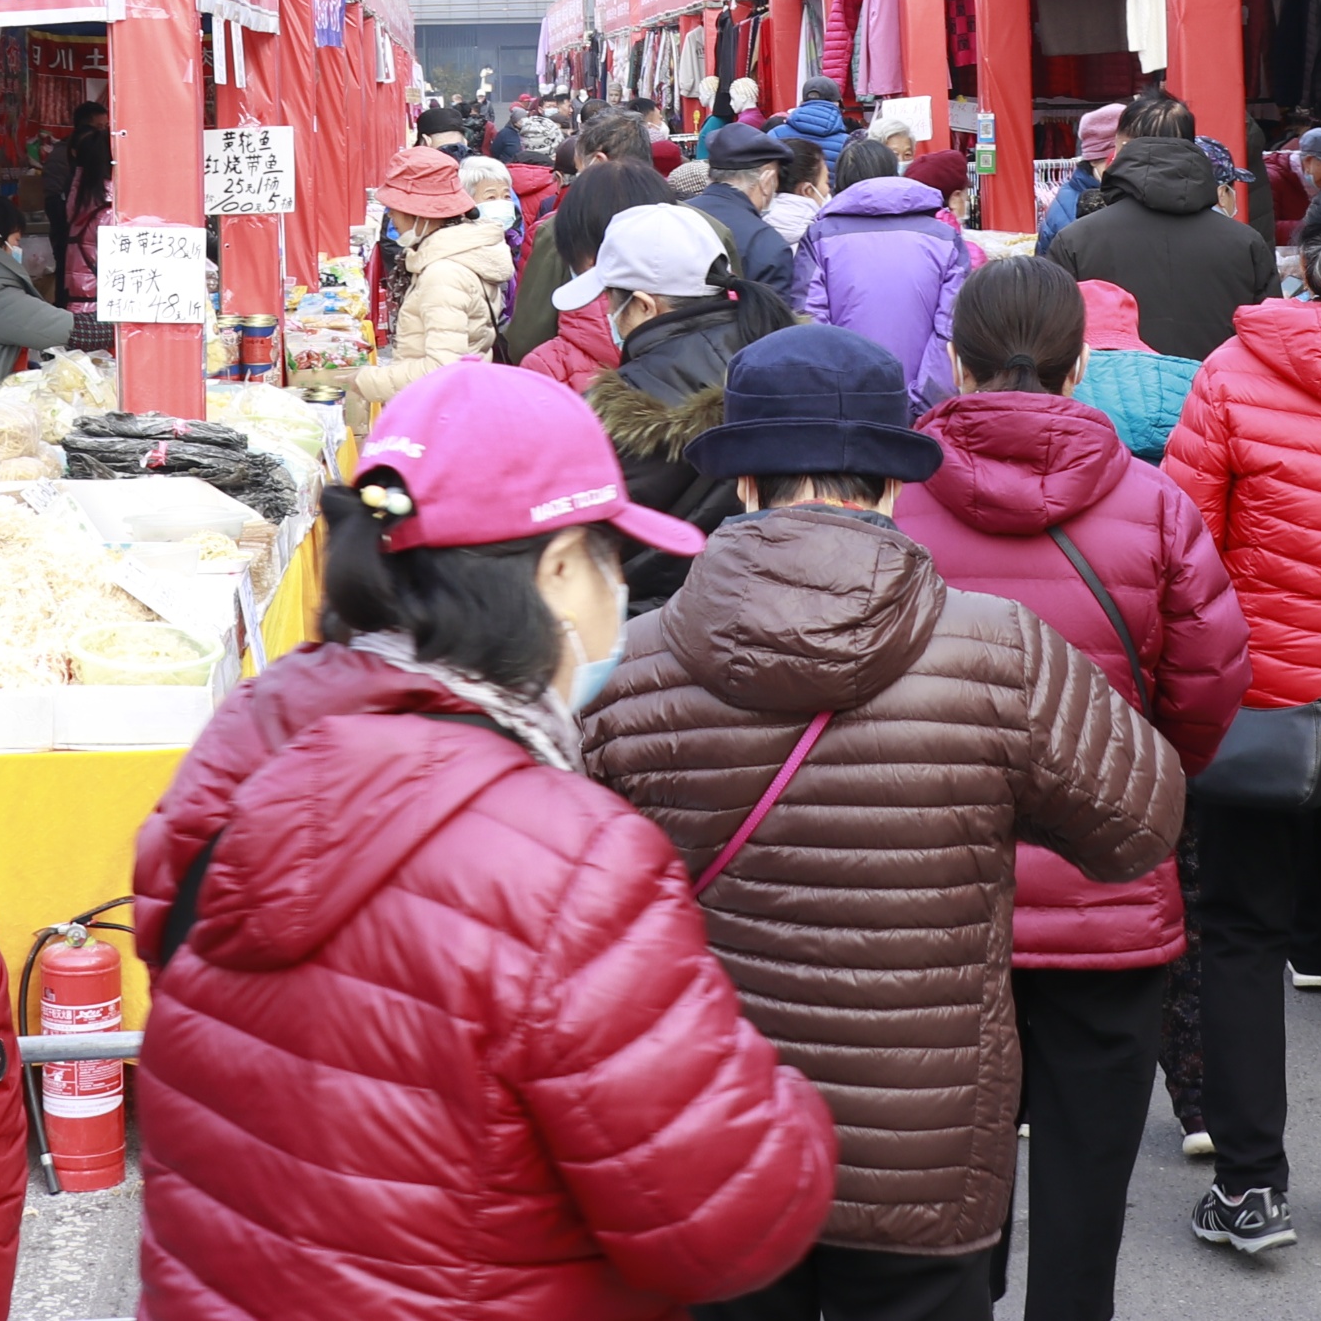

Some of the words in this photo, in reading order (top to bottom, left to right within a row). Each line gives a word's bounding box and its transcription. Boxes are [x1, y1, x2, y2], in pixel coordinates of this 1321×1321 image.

[222, 130, 272, 154] 黄花鱼
[204, 154, 283, 176] 红烧带鱼
[104, 268, 162, 294] 海带头
